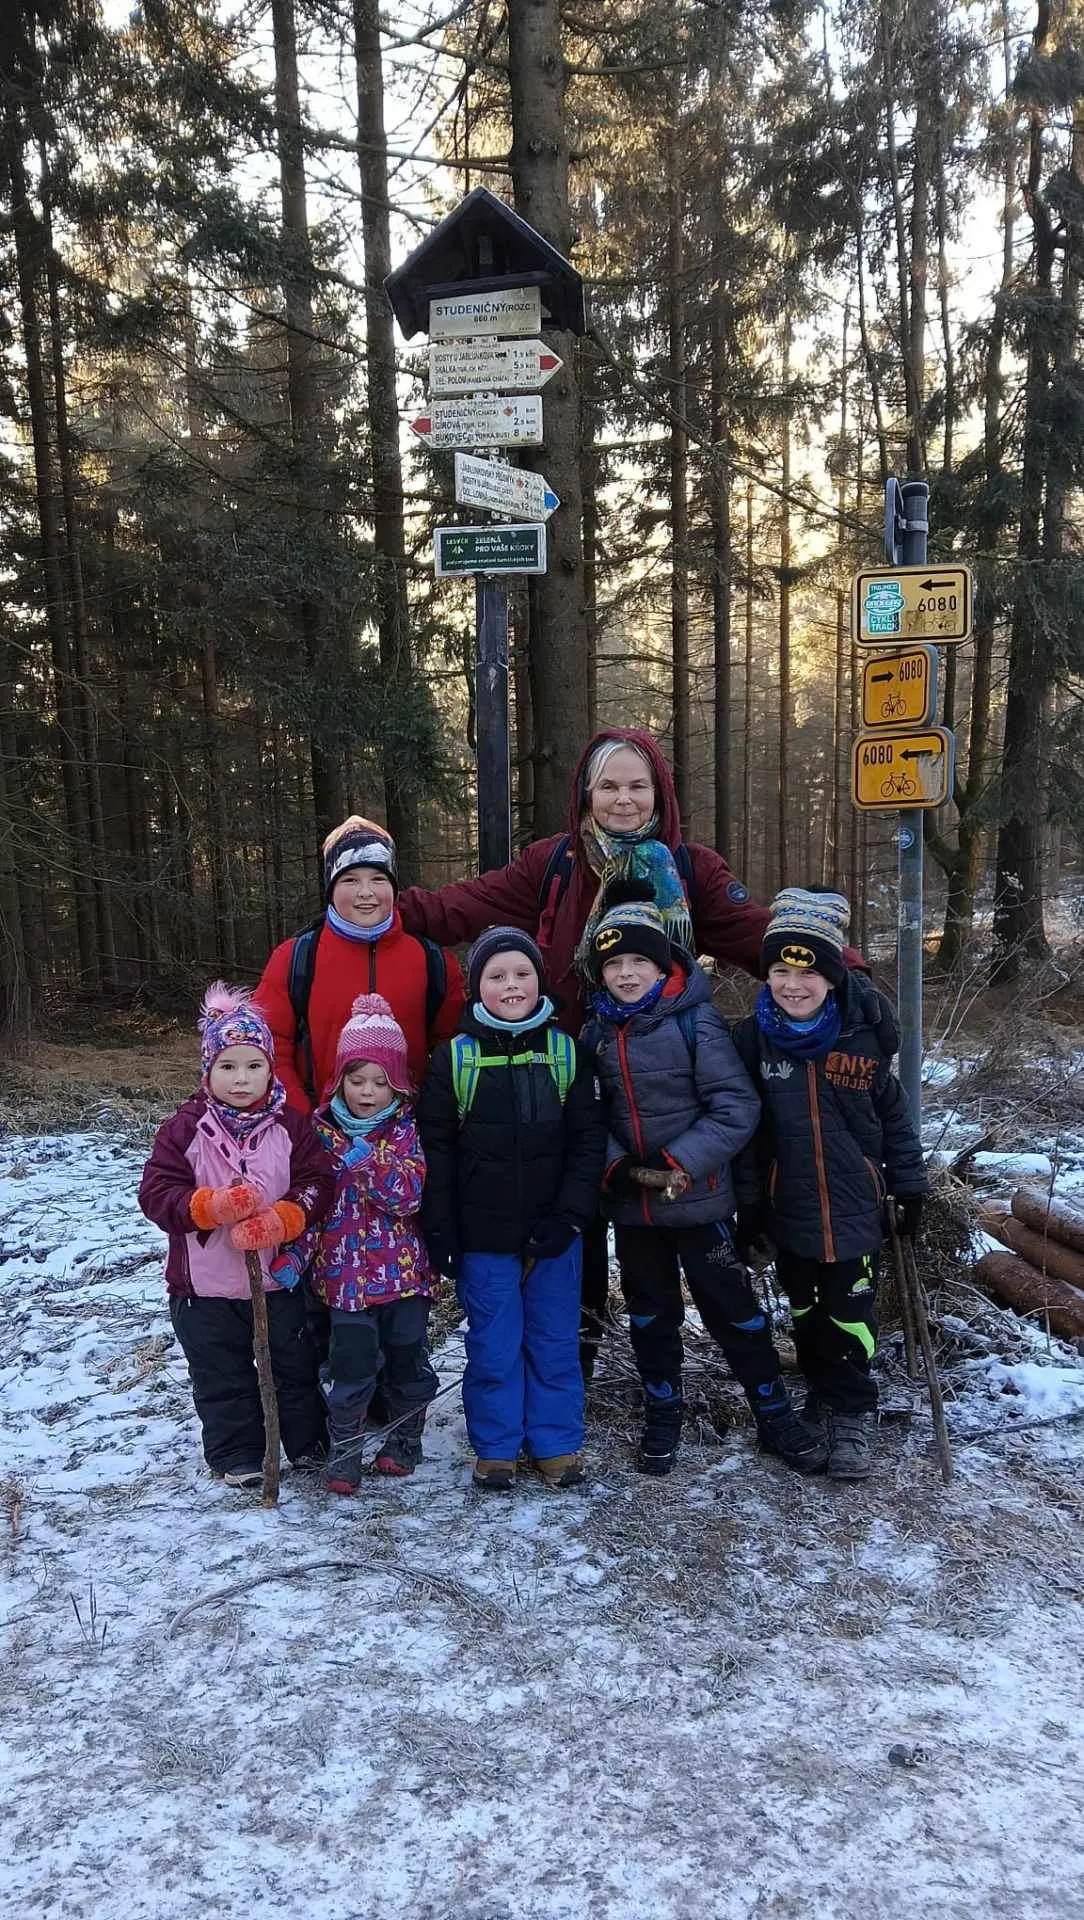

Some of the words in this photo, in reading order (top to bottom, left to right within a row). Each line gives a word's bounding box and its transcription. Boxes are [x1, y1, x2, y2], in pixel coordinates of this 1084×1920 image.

[436, 302, 506, 315] STUDENIČNÝ
[475, 545, 490, 553] PRO
[491, 543, 509, 552] VAŠE
[918, 594, 957, 613] 6080
[899, 658, 923, 683] 6080
[862, 744, 893, 766] 6080
